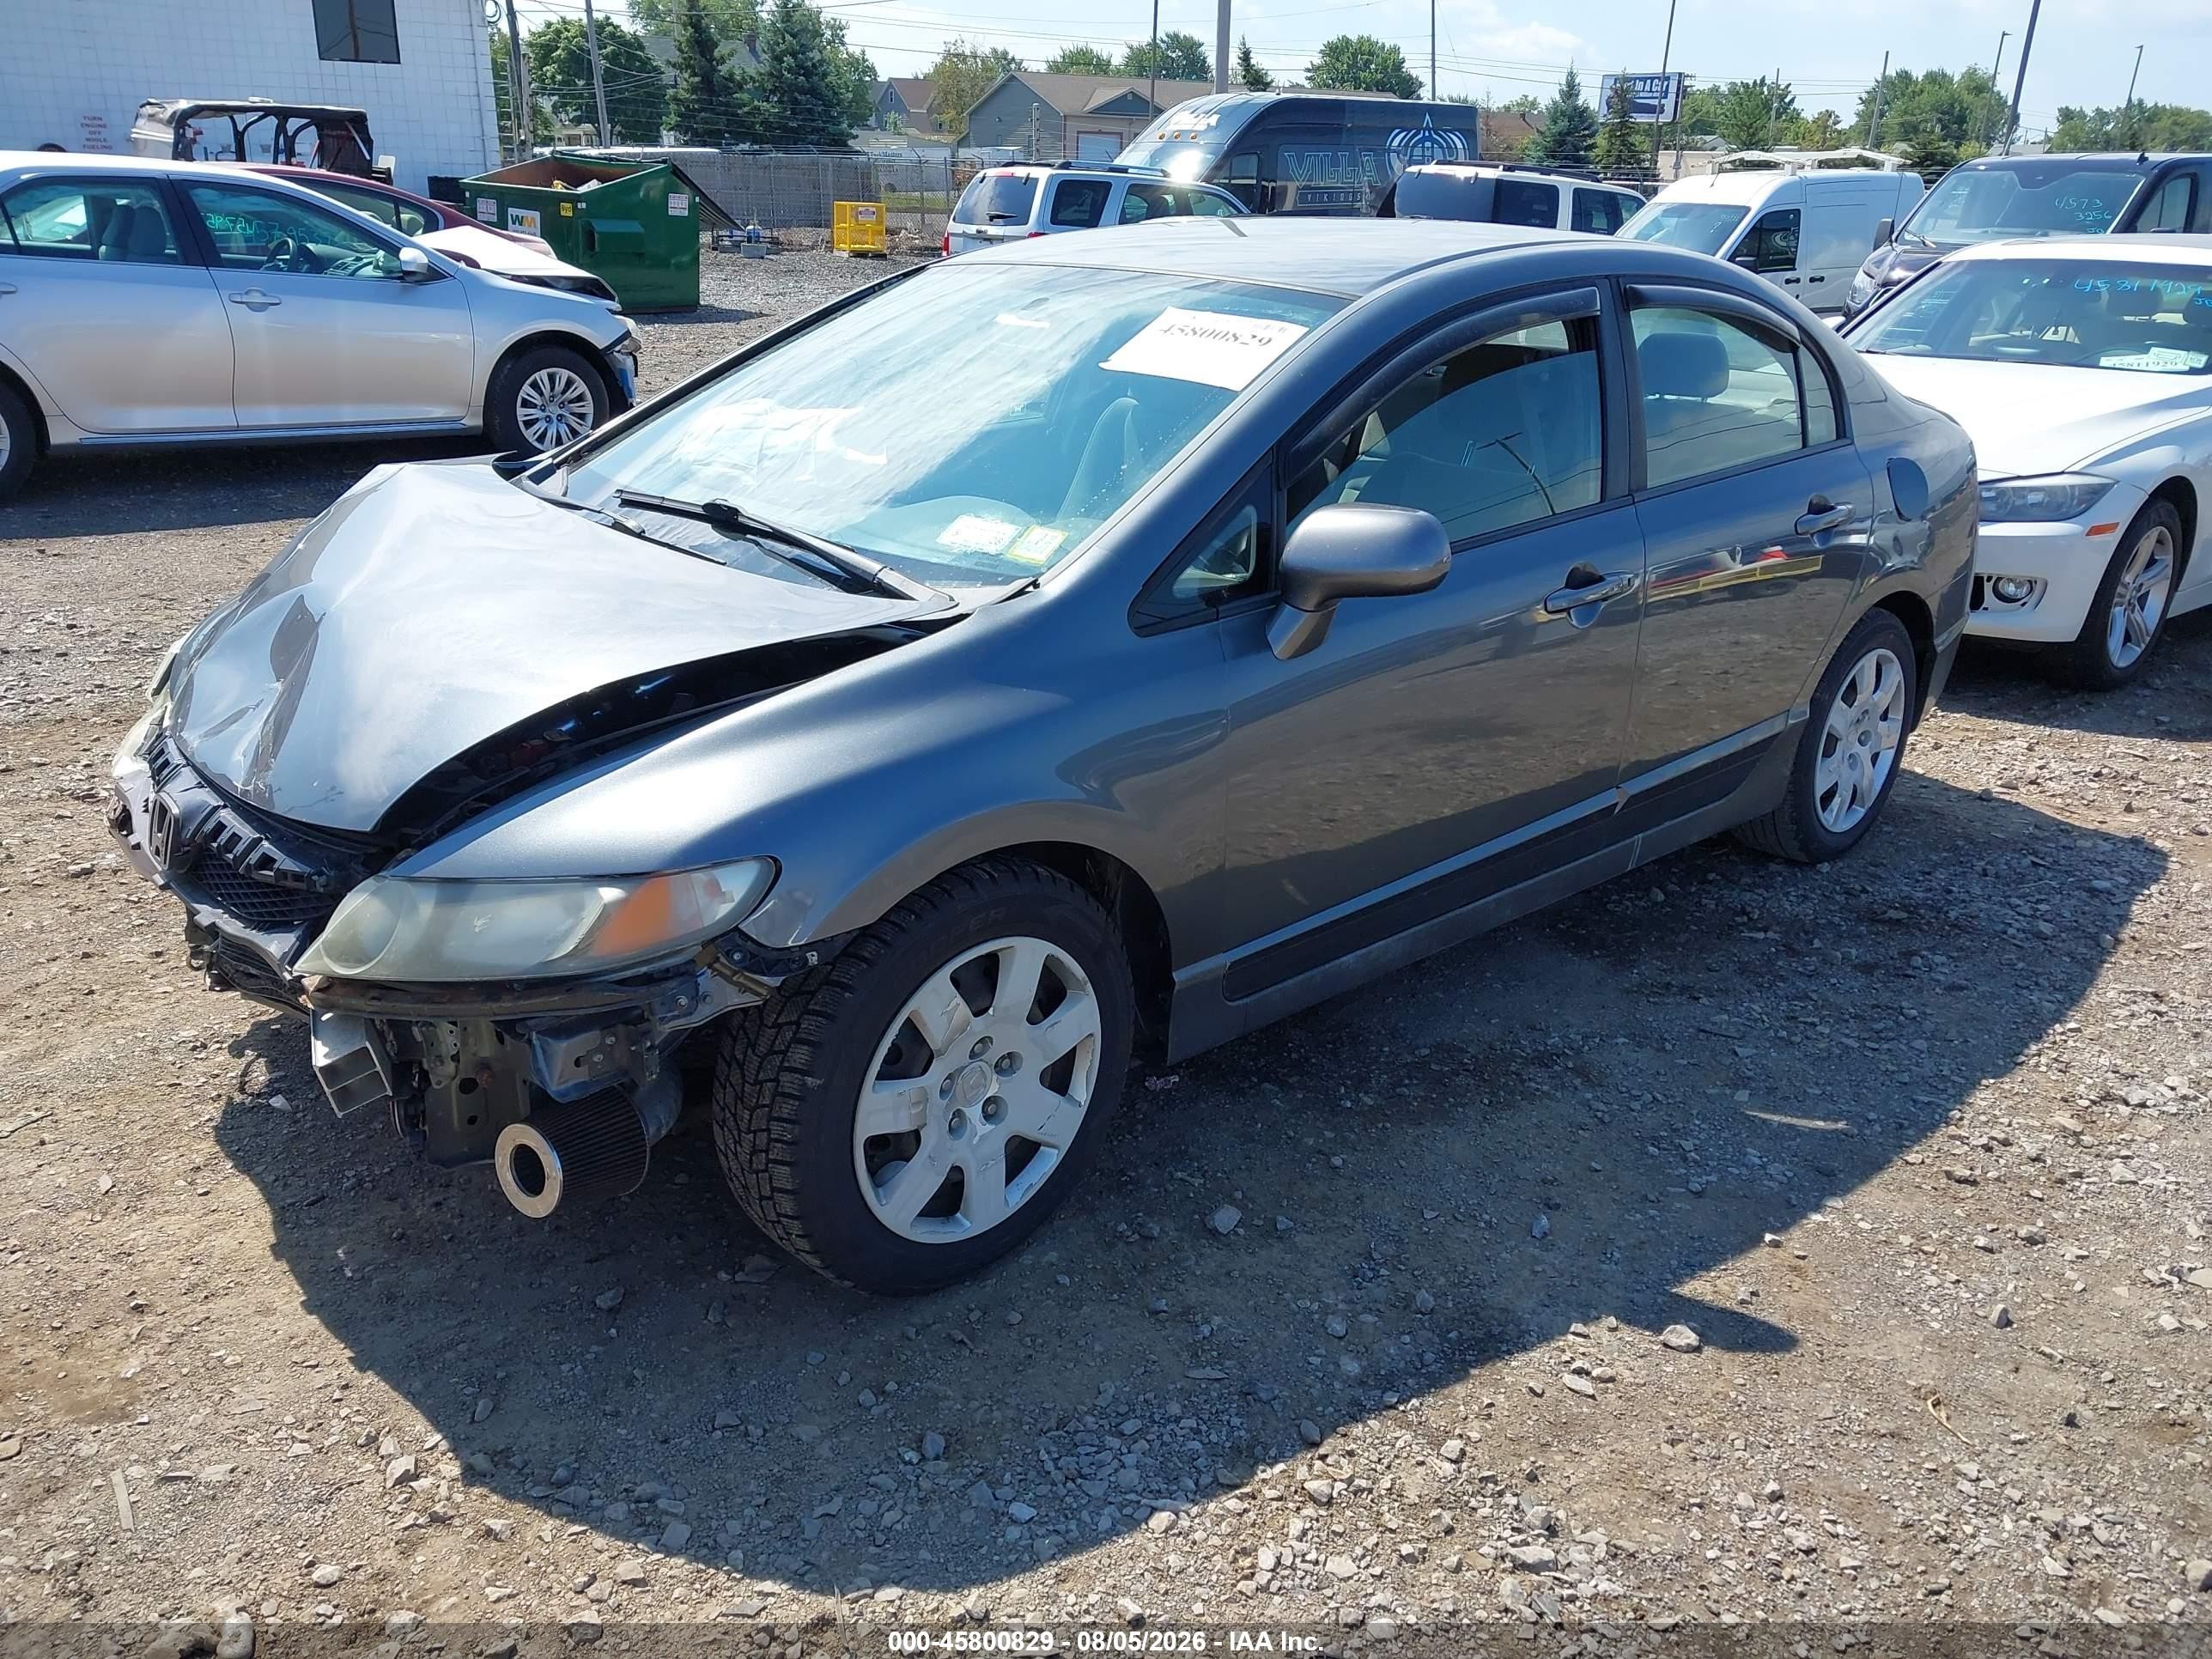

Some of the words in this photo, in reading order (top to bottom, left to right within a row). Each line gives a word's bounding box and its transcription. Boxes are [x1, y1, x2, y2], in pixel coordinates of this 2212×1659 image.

[1284, 151, 1382, 189] VILLA
[1307, 191, 1362, 203] VIKINGS
[510, 213, 537, 228] WM
